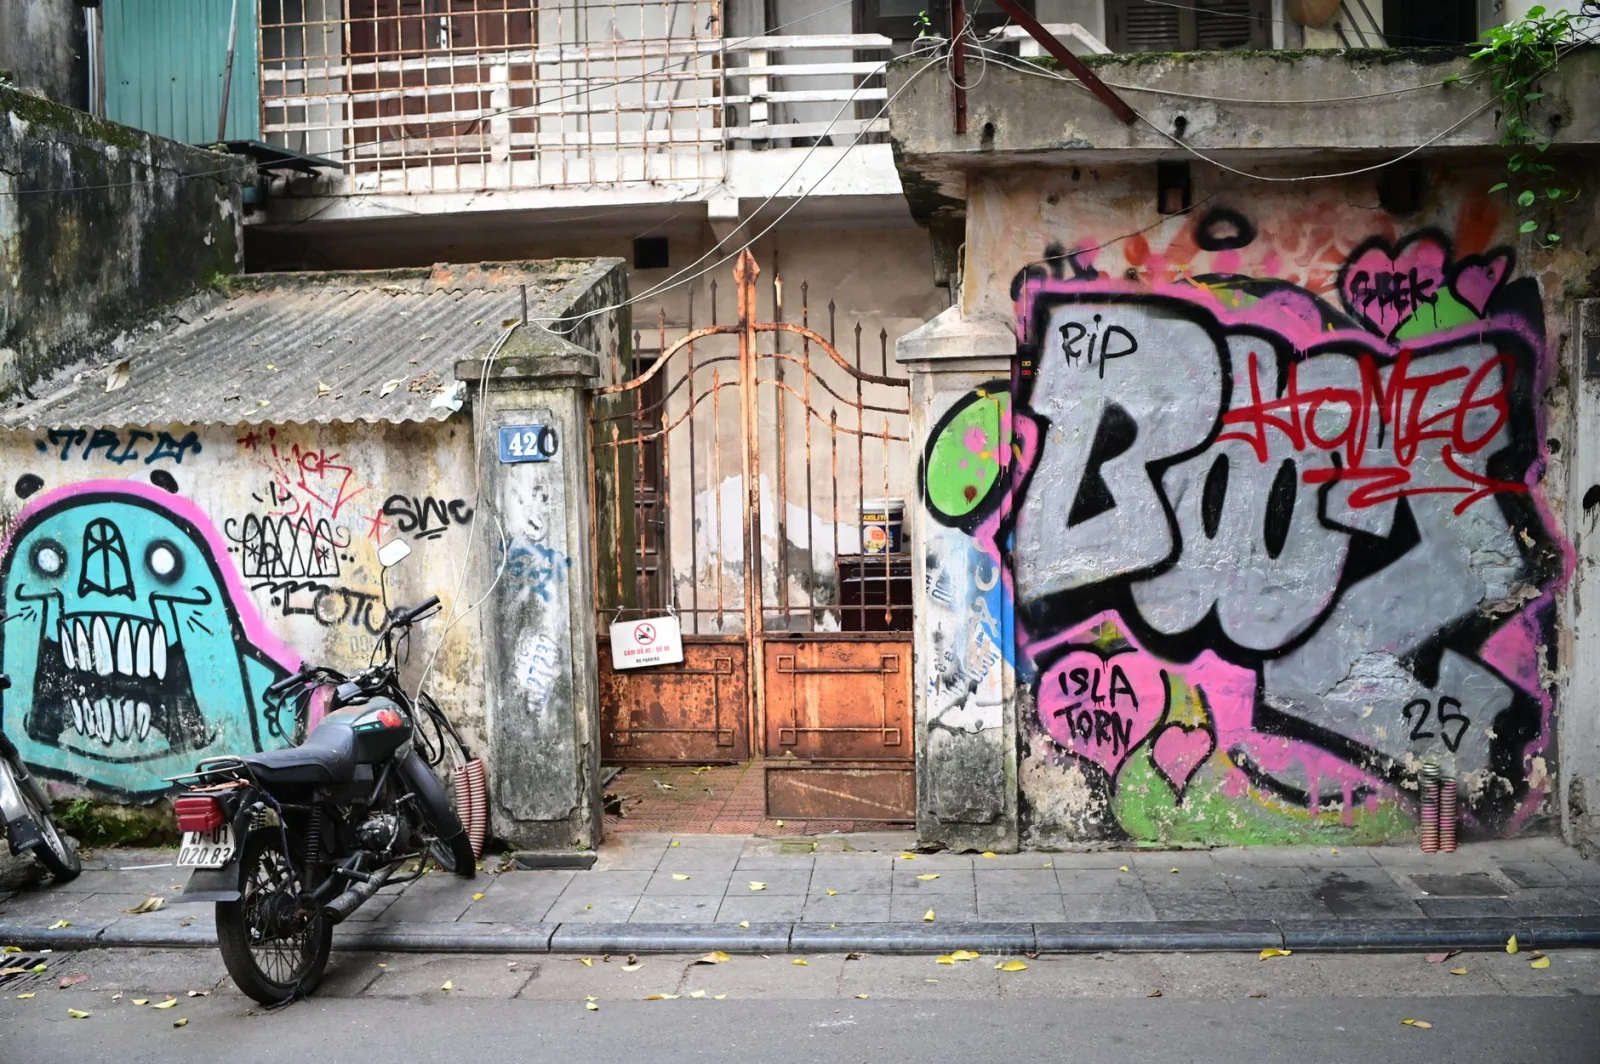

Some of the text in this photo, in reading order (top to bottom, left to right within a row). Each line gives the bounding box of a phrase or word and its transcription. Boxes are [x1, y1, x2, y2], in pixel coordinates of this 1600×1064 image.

[1059, 664, 1139, 709] ISLA
[1053, 702, 1133, 756] TORN
[1403, 695, 1471, 753] 25
